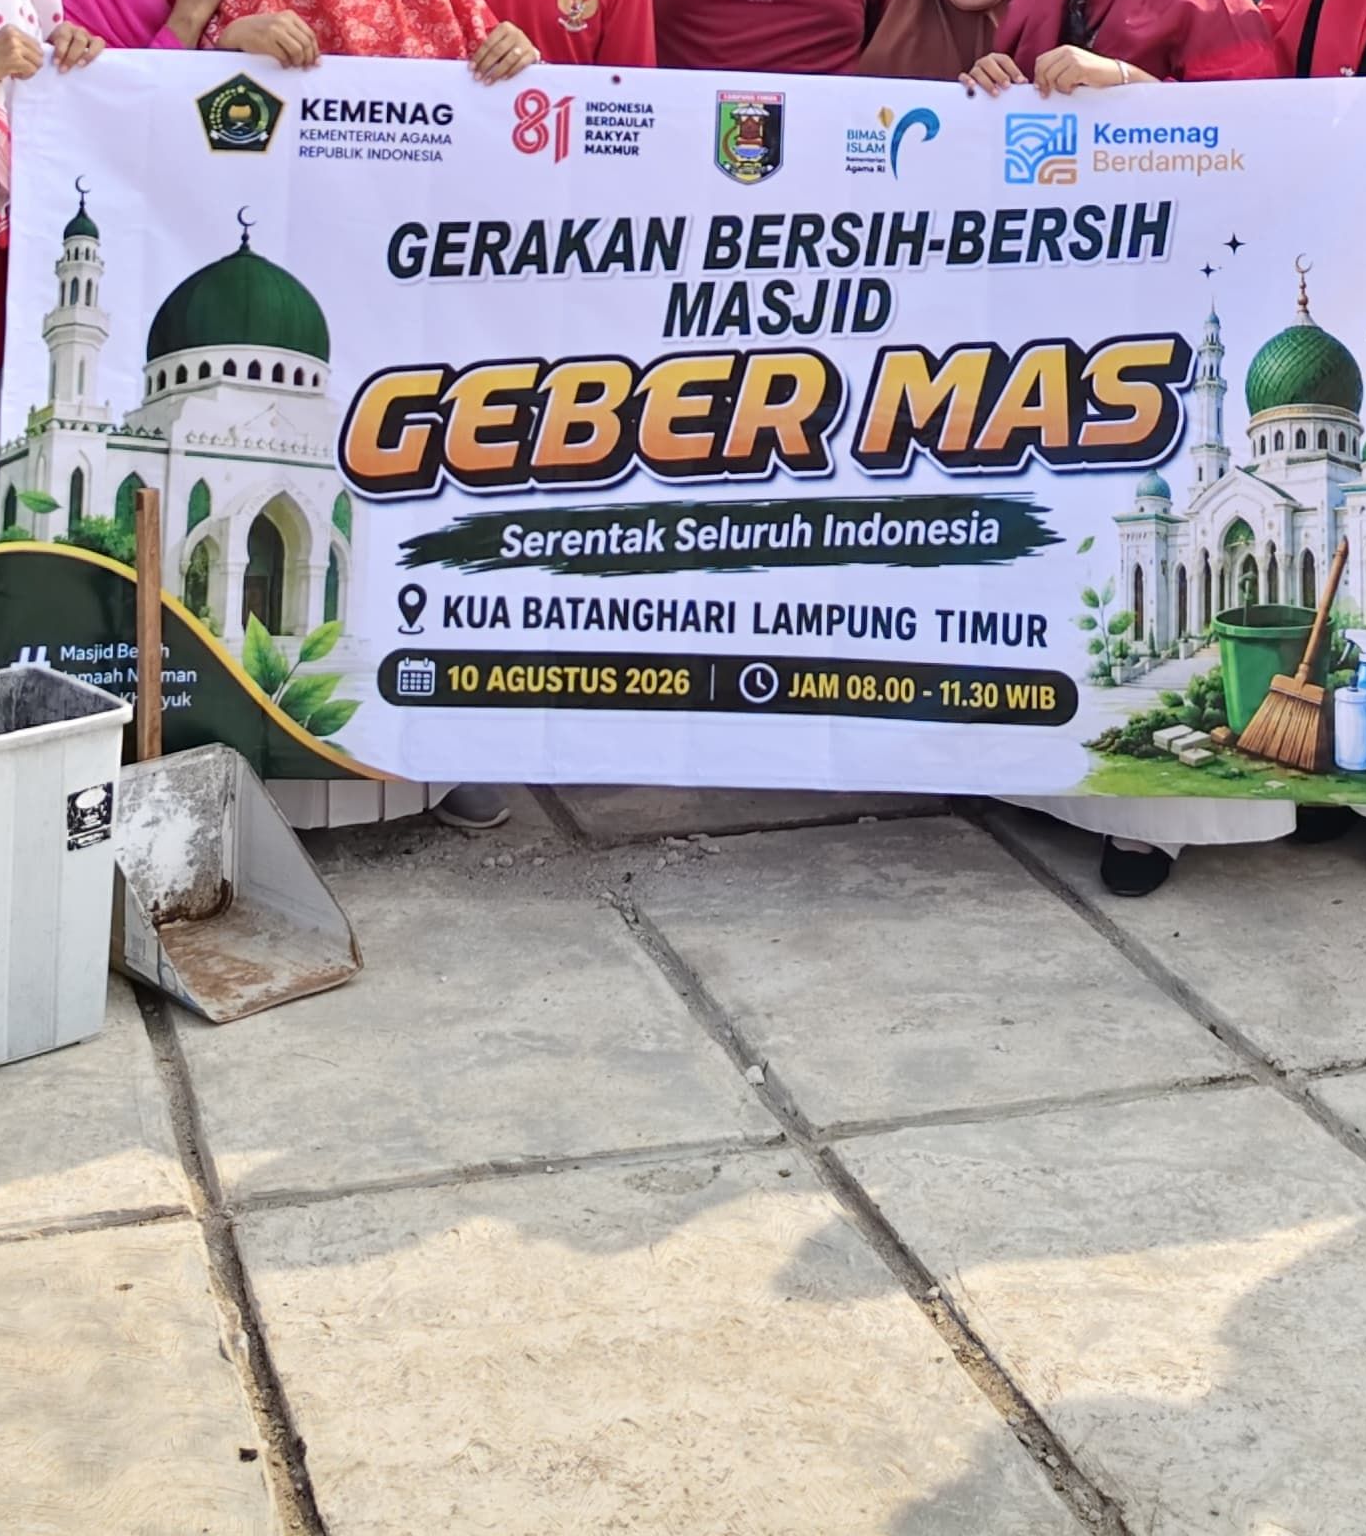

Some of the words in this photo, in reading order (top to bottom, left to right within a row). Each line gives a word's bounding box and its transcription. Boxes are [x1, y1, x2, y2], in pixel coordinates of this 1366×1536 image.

[300, 98, 454, 125] KEMENAG
[585, 101, 654, 114] INDONESIA
[512, 88, 576, 164] 81
[585, 116, 656, 129] BERDAULAT
[846, 129, 887, 141] BIMAS
[1093, 122, 1219, 148] Kemenag
[299, 128, 396, 143] KEMENTERIAN
[400, 132, 453, 145] AGAMA
[585, 130, 640, 143] RAKYAT
[846, 142, 886, 154] ISLAM
[299, 145, 363, 160] REPUBLIK
[367, 148, 443, 162] INDONESIA
[584, 144, 640, 156] MAKMUR
[1092, 149, 1246, 177] Berdampak
[845, 164, 875, 174] Agama
[877, 165, 886, 173] RI
[386, 216, 687, 280] GERAKAN
[701, 200, 1173, 270] BERSIH-BERSIH
[662, 277, 893, 338] MASJID
[340, 350, 837, 490] GEBER
[852, 335, 1187, 467] MAS
[499, 518, 667, 559] Serentak
[674, 513, 813, 552] Seluruh
[822, 510, 1000, 548] Indonesia
[442, 595, 511, 629] KUA
[522, 596, 737, 634] BATANGHARI
[752, 602, 917, 641] LAMPUNG
[934, 609, 1048, 648] TIMUR
[59, 643, 114, 663] Masjid
[447, 664, 479, 692] 10
[486, 665, 618, 694] AGUSTUS
[625, 668, 691, 696] 2026
[788, 672, 840, 700] JAM
[846, 674, 915, 704] 08.00
[939, 679, 999, 709] 11.30
[1005, 682, 1056, 711] WIB
